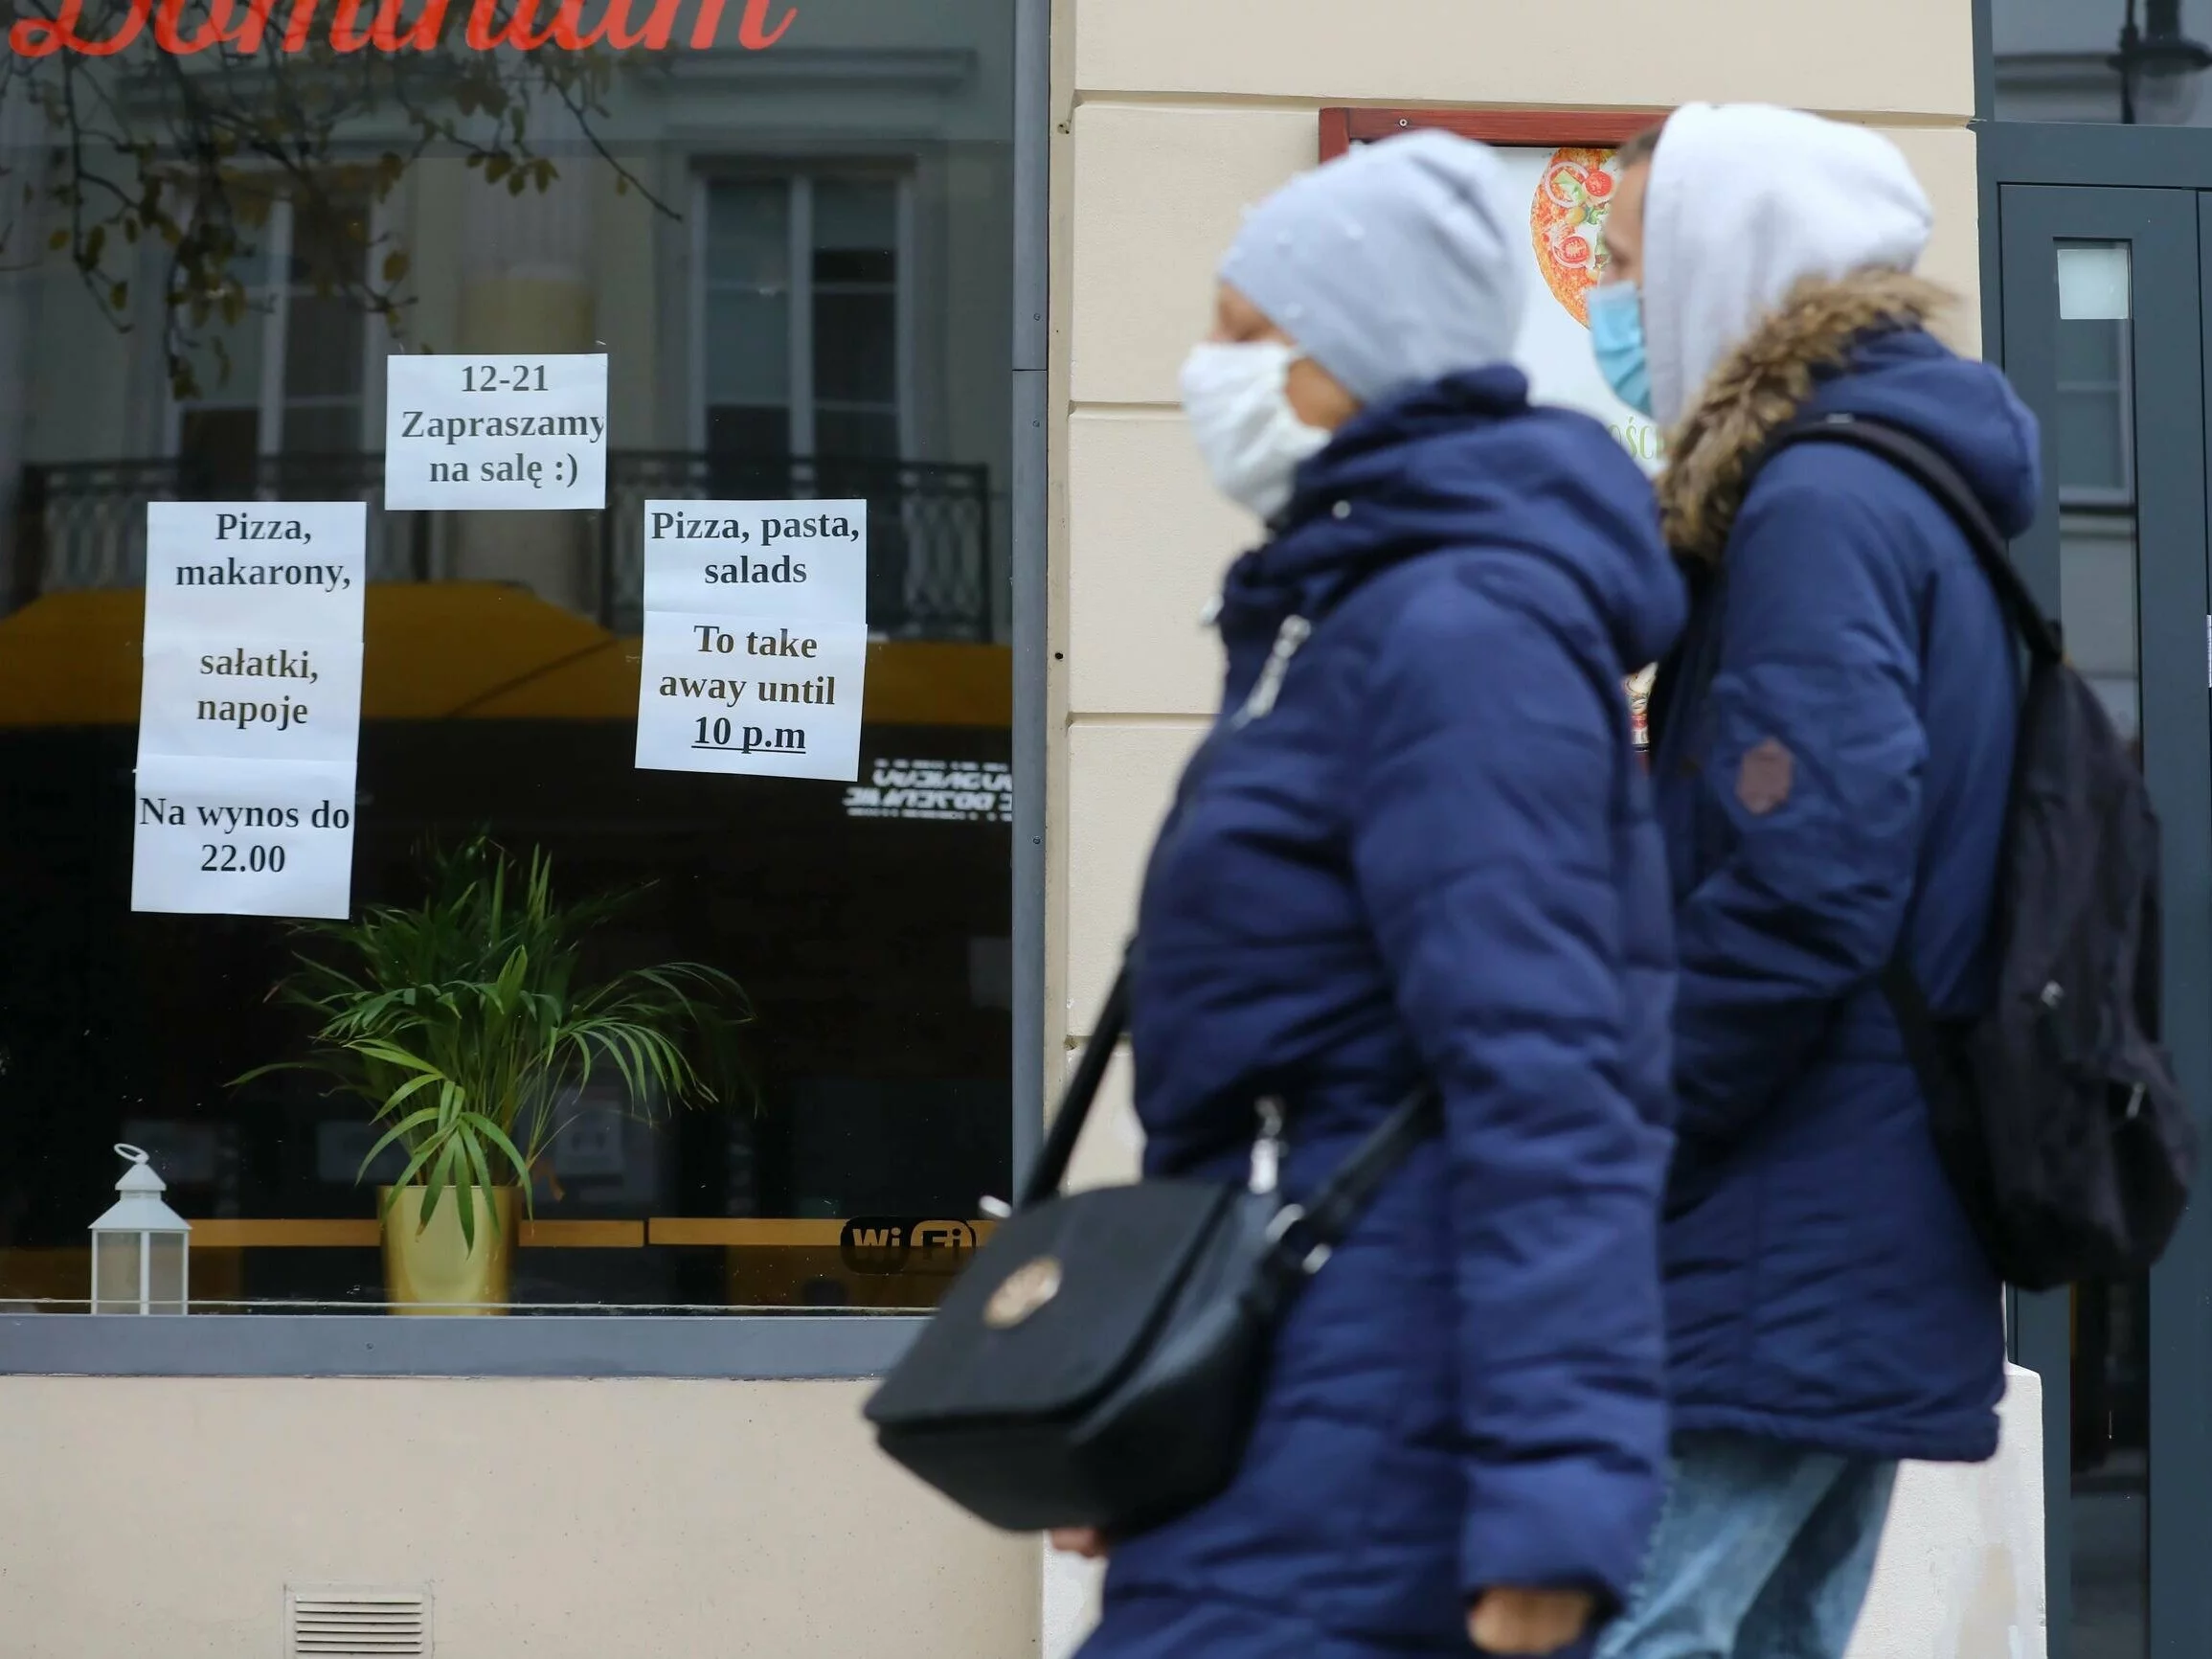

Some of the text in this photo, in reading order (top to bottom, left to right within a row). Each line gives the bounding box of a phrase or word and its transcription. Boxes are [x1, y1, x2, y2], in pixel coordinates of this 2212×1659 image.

[462, 365, 550, 393] 12-21
[401, 411, 604, 446] Zapraszamy
[429, 462, 470, 482] na
[481, 452, 543, 489] salę
[215, 511, 312, 546] Pizza,
[651, 511, 860, 548] Pizza, pasta,
[176, 557, 351, 591] makarony,
[705, 555, 808, 585] salads
[693, 625, 819, 660] To take
[200, 648, 319, 685] sałatki,
[659, 675, 836, 709] away until
[197, 695, 309, 733] napoje
[693, 716, 807, 755] 10 p.m
[139, 797, 350, 836] Na wynos do
[200, 844, 286, 874] 22.00
